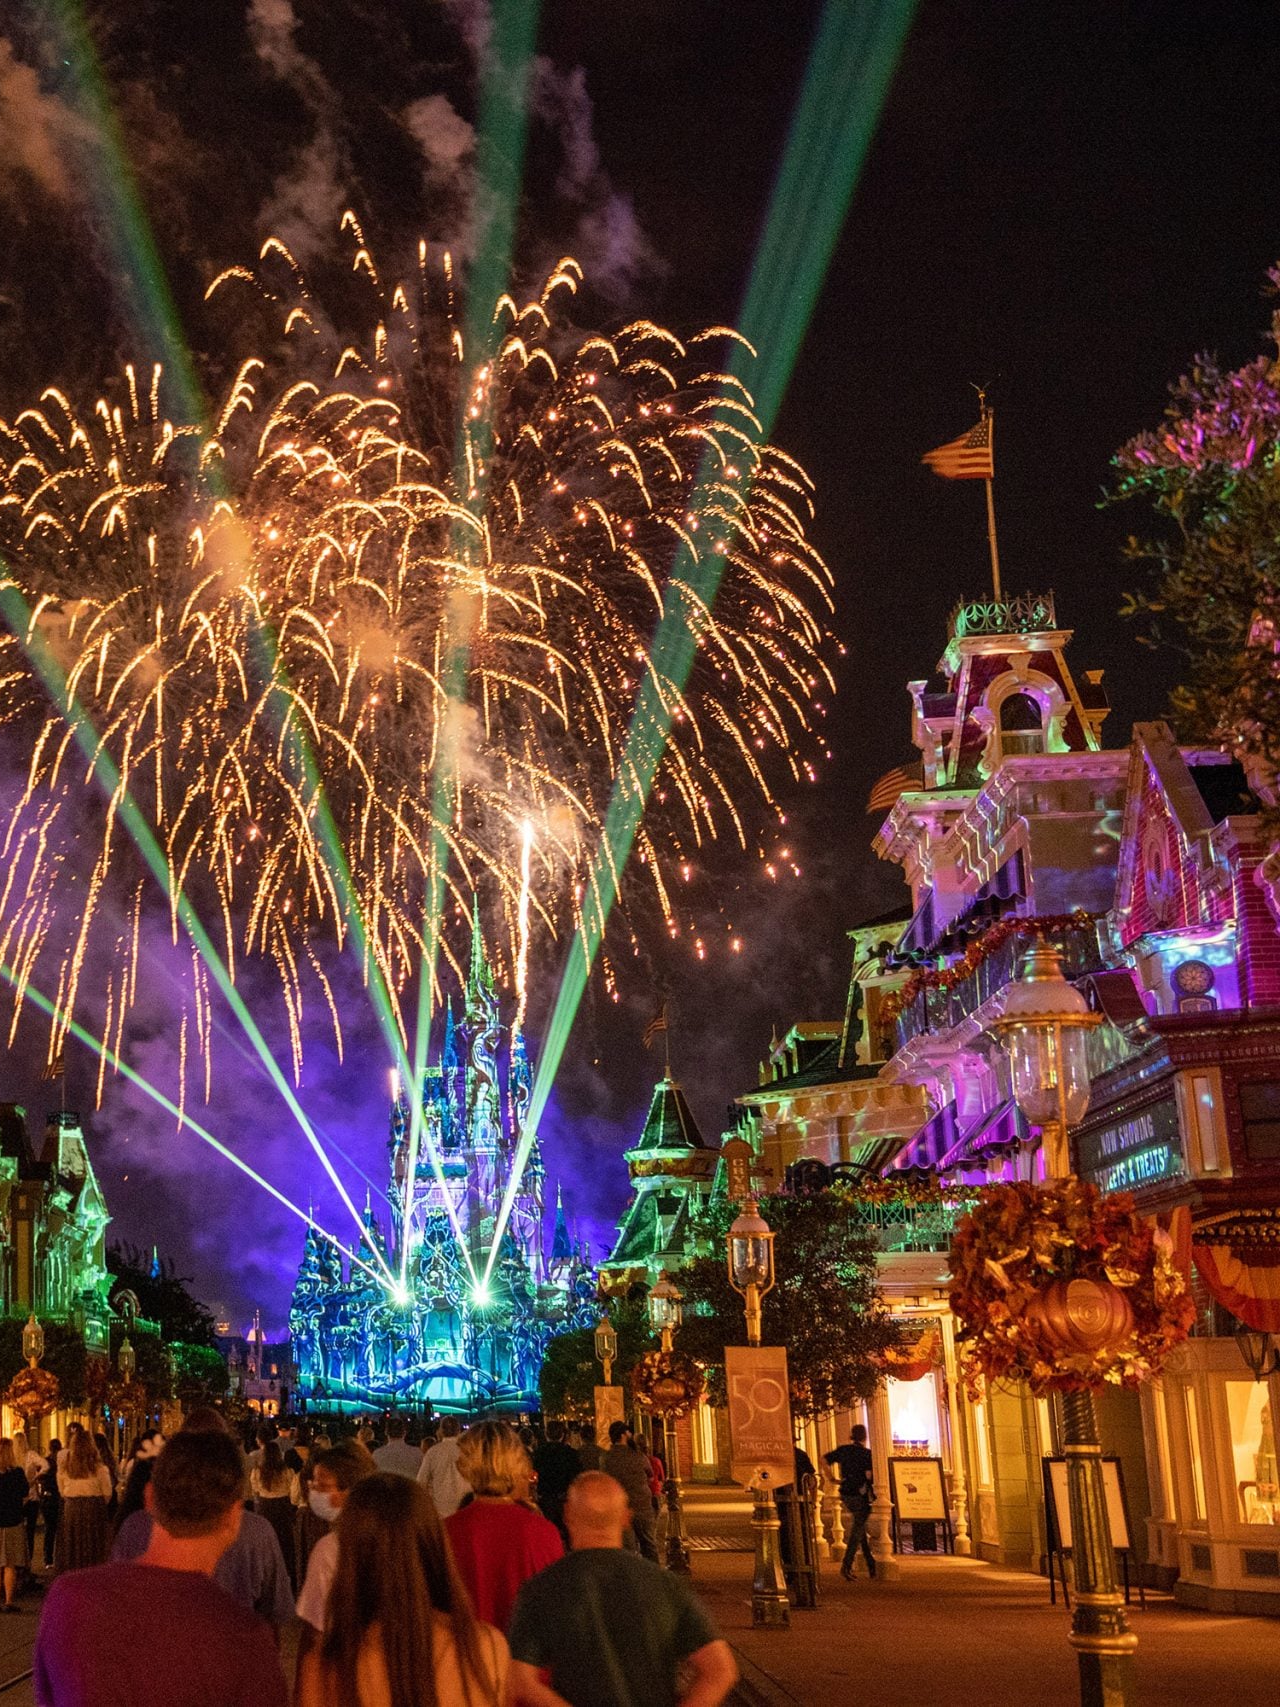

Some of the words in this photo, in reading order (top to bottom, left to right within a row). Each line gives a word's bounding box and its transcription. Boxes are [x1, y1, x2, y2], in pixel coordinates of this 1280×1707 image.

[1101, 1129, 1118, 1156] NOW
[1119, 1114, 1154, 1149] SHOWING
[733, 1158, 746, 1197] CRYS
[1135, 1146, 1168, 1180] TREATS"
[732, 1374, 785, 1430] 50
[739, 1441, 786, 1450] MAGICAL
